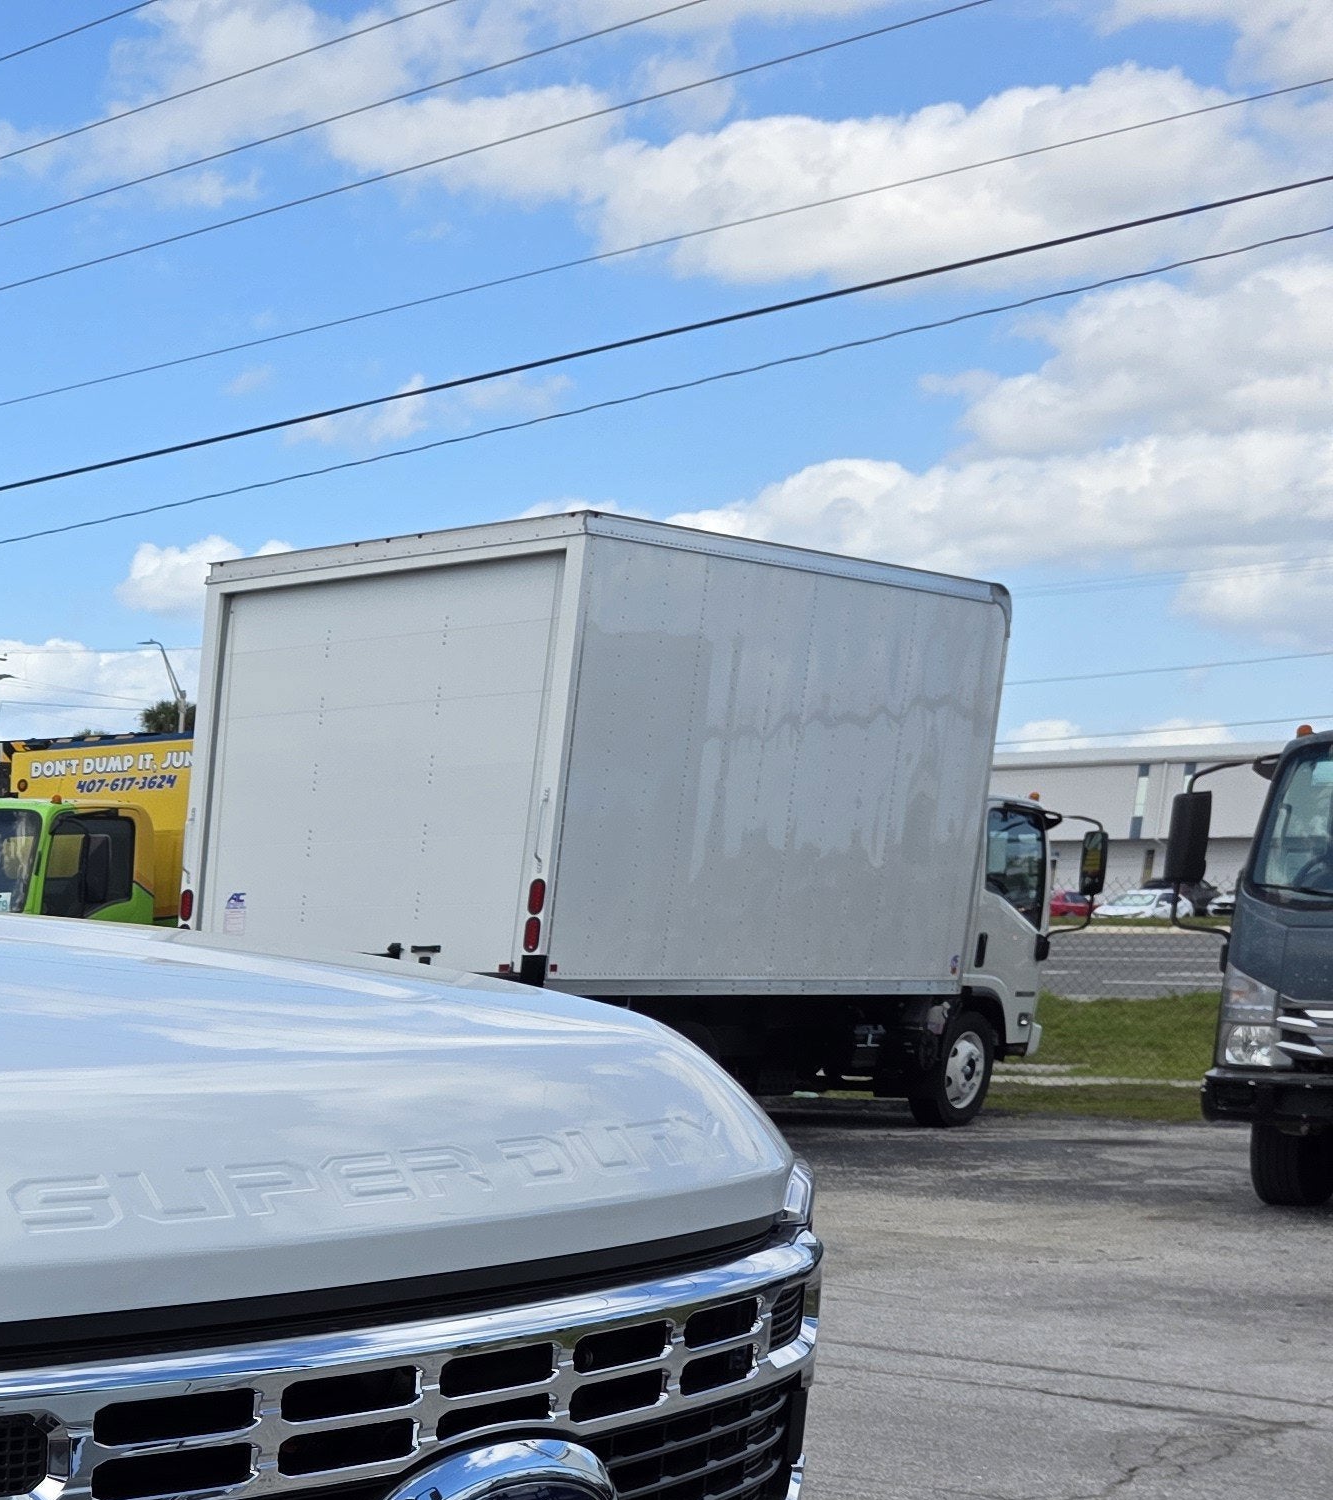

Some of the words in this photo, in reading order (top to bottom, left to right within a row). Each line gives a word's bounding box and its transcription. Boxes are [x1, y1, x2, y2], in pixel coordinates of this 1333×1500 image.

[30, 759, 80, 778] DON'T
[82, 754, 134, 774] DUMP
[137, 753, 157, 773] IT,
[76, 774, 177, 793] 407-617-3624
[7, 1144, 494, 1236] SUPER
[496, 1112, 728, 1186] DUTY
